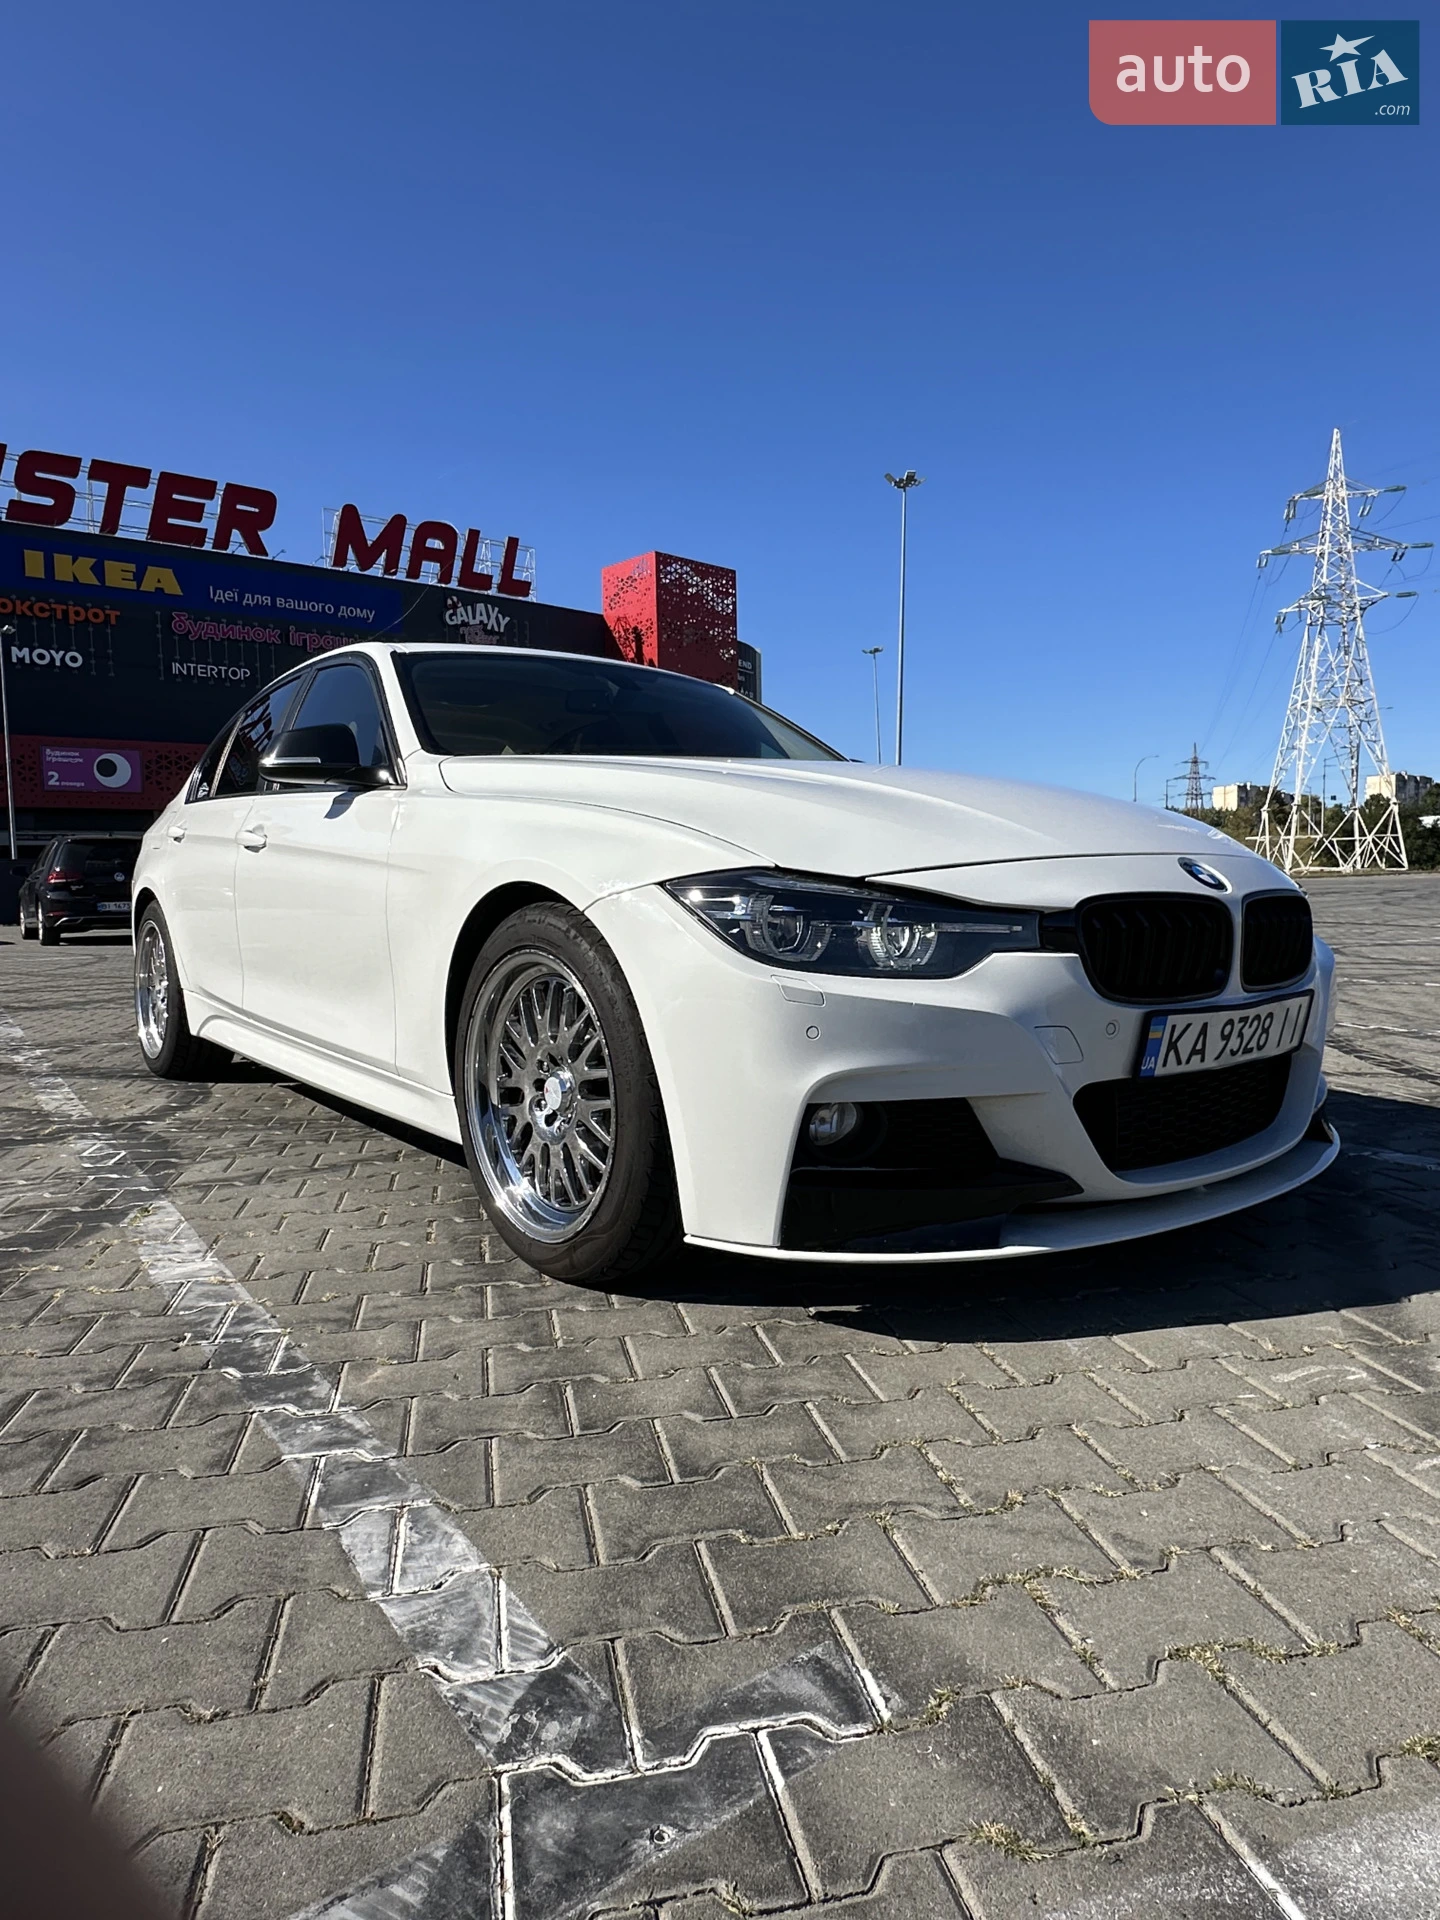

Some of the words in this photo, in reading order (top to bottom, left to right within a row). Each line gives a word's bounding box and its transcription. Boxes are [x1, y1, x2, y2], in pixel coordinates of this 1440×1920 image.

[0, 443, 277, 557] STER
[331, 503, 532, 598] MALL
[24, 549, 183, 595] IKEA
[209, 585, 239, 603] Ідеї
[243, 593, 271, 607] для
[276, 597, 335, 614] вашого
[338, 605, 375, 623] дому
[445, 602, 511, 633] GALAXY
[171, 611, 281, 645] будинок
[11, 646, 83, 668] MOYO
[171, 662, 250, 681] INTERTOP
[47, 770, 60, 786] 2
[1162, 1021, 1209, 1068] KA
[1214, 1011, 1274, 1061] 9328
[1141, 1056, 1155, 1070] UA
